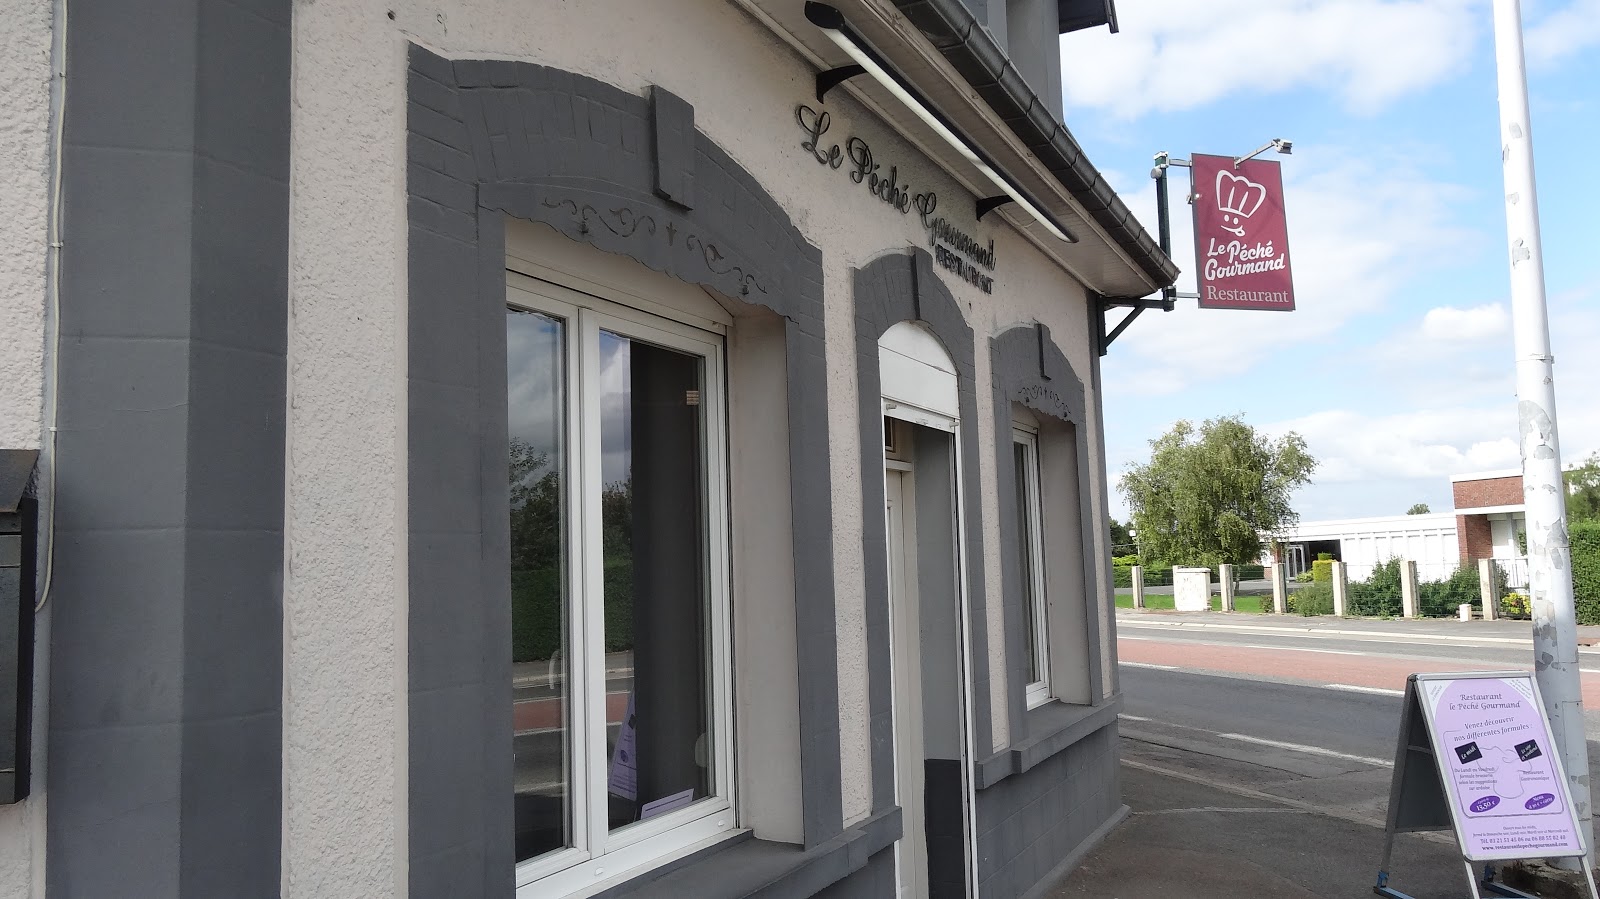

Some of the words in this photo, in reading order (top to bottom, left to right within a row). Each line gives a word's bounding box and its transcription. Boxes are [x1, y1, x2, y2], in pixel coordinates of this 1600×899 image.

[796, 105, 844, 170] Le
[847, 137, 911, 214] Péché
[914, 193, 996, 271] Gourmand
[1207, 237, 1226, 257] Le
[1227, 240, 1275, 264] Péché
[935, 244, 994, 295] RESTAURANT
[1204, 253, 1285, 281] Gourmand
[1206, 285, 1289, 303] Restaurant
[1460, 693, 1502, 701] Restaurant
[1480, 700, 1521, 710] Gourmand
[1464, 722, 1483, 730] Venez
[1484, 716, 1515, 727] découvrir
[1466, 729, 1501, 741] différentes
[1501, 723, 1529, 735] formules
